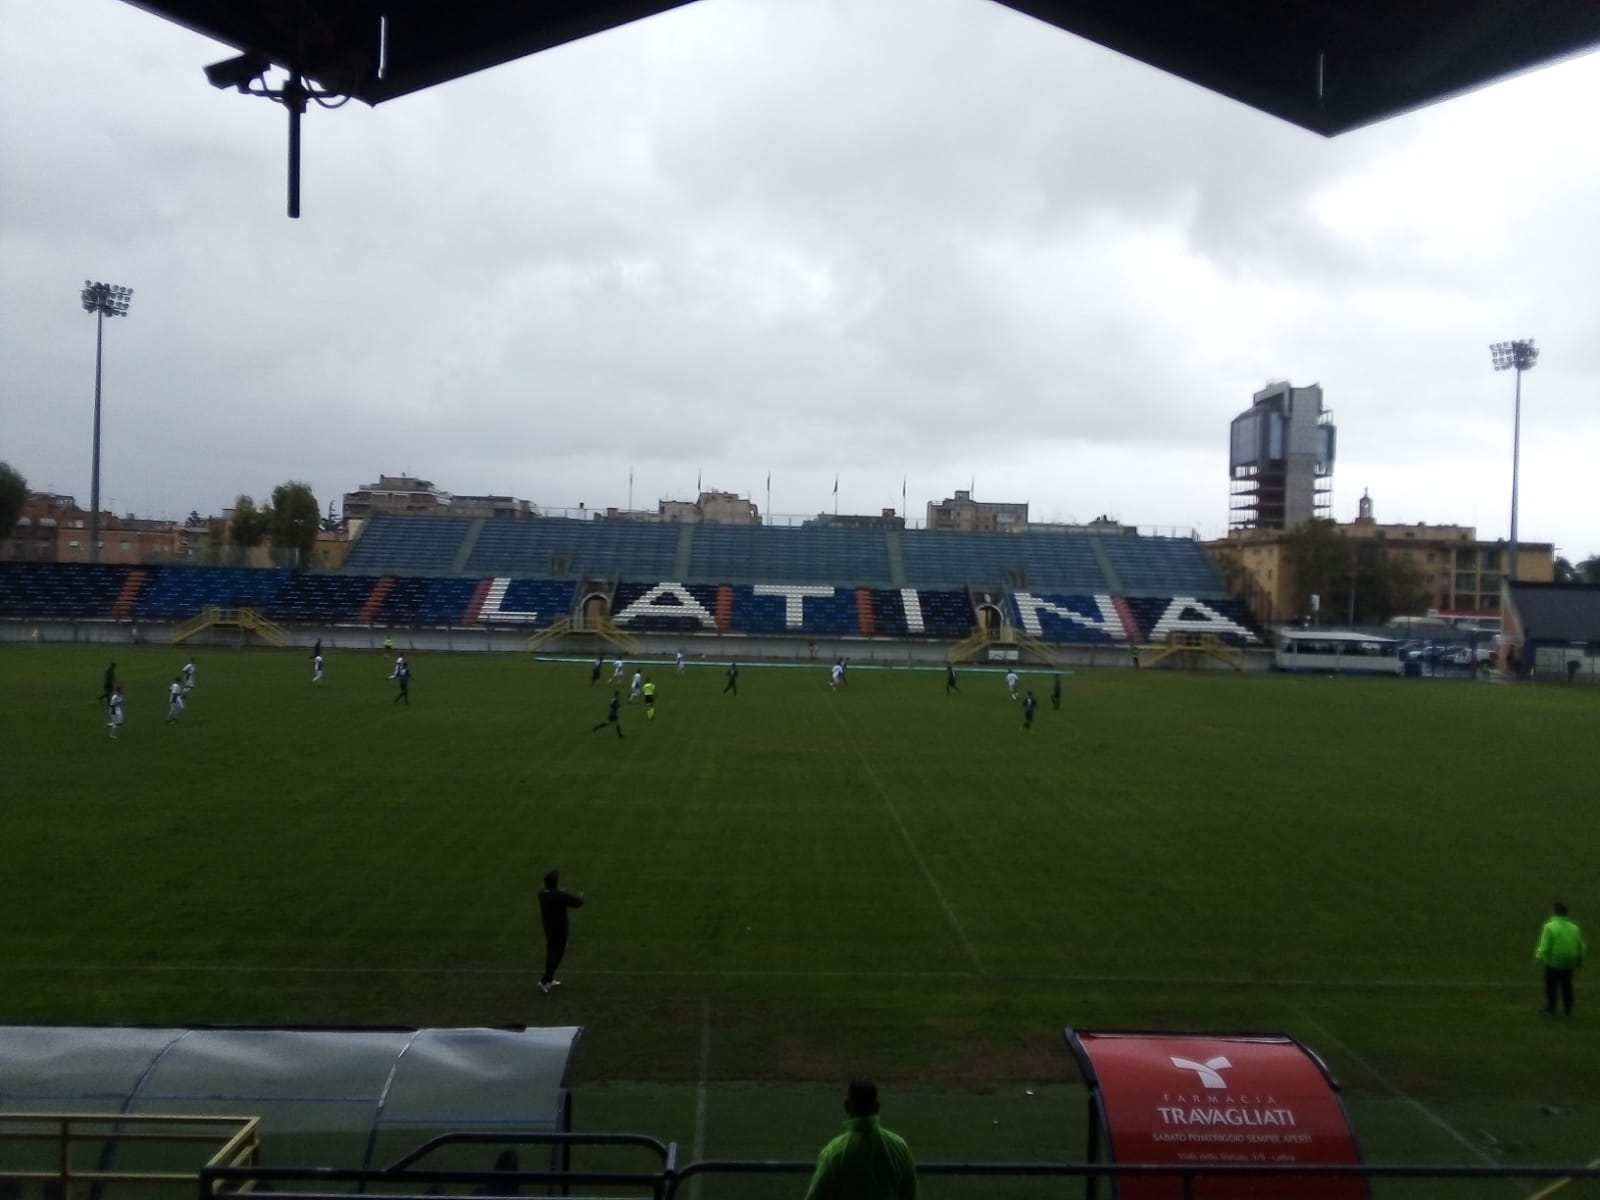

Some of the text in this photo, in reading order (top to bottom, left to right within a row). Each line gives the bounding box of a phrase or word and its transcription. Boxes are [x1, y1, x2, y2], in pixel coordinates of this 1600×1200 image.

[478, 576, 1257, 641] LATINA
[1163, 1094, 1276, 1104] FARMACIA
[1157, 1107, 1296, 1126] TRAVAGLIATI
[1152, 1133, 1186, 1143] SABATO
